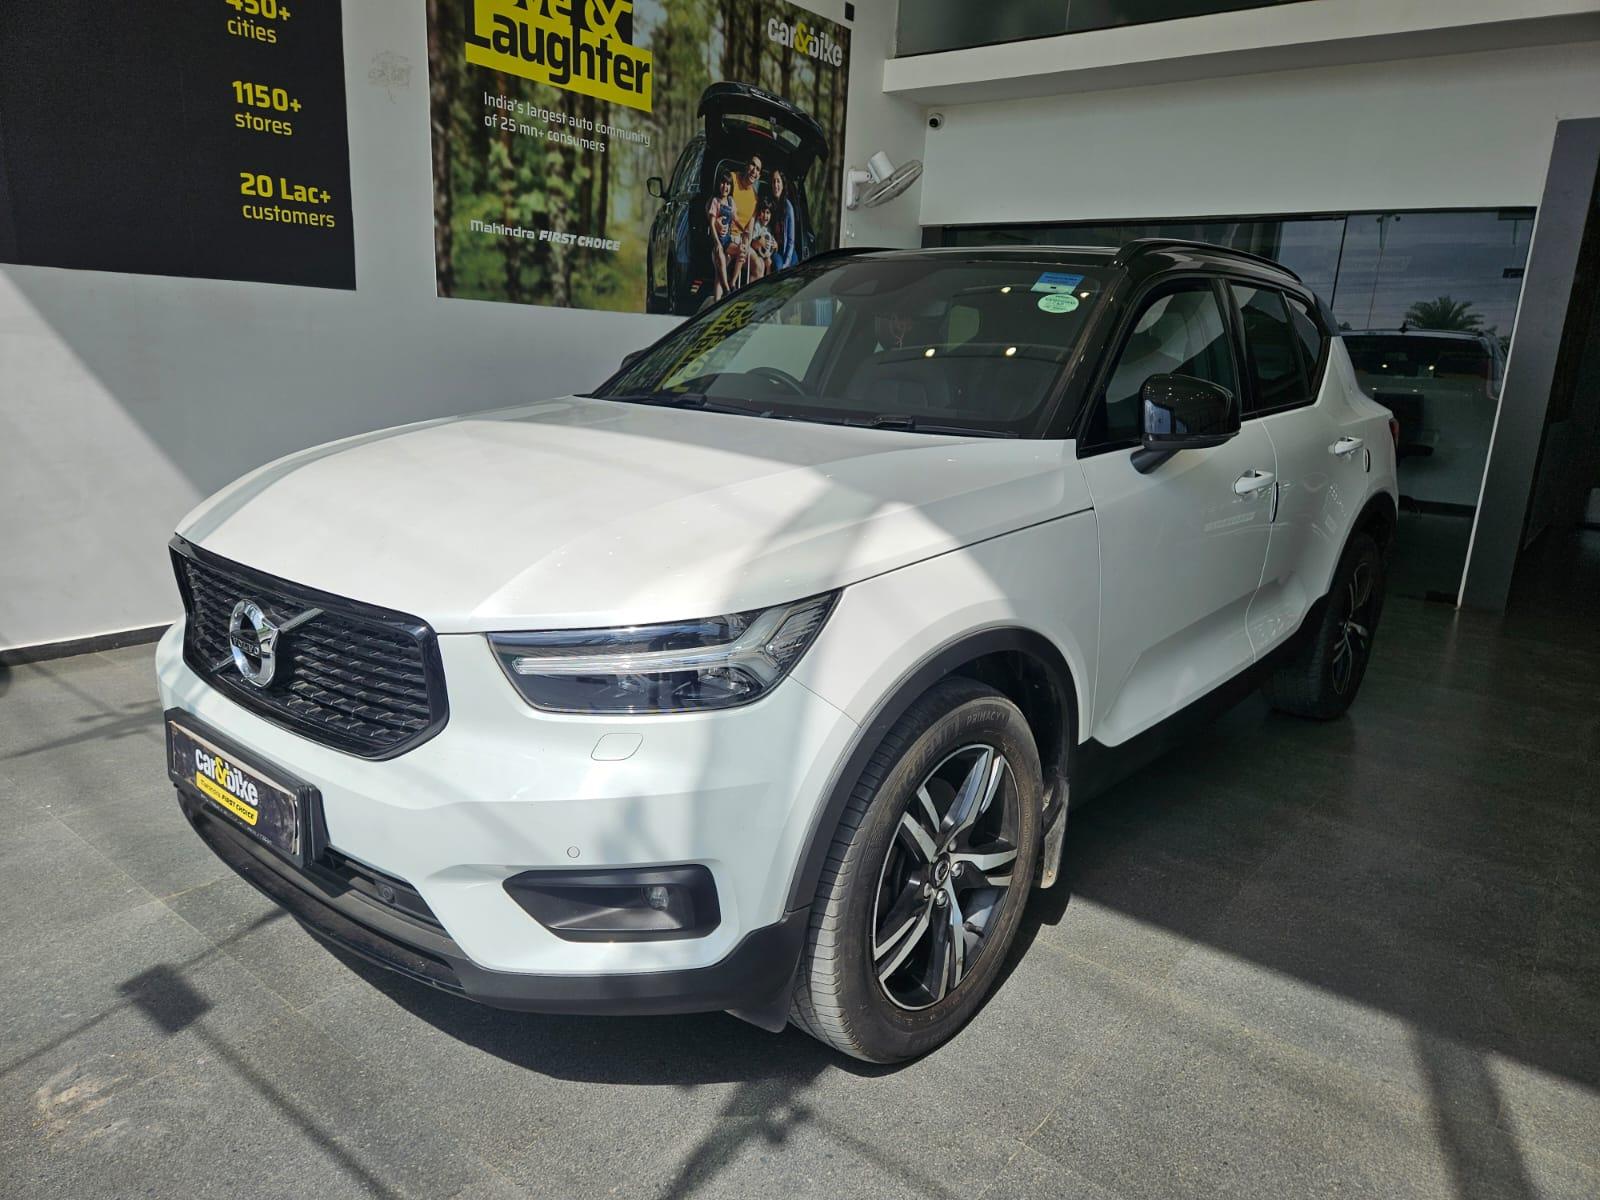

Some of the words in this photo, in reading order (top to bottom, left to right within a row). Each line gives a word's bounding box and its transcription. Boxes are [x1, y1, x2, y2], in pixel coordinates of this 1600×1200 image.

[227, 17, 277, 44] cities
[768, 18, 842, 67] car&bike
[465, 0, 650, 94] Laughter
[232, 81, 302, 112] 1150+
[235, 112, 293, 136] stores
[484, 91, 524, 114] India's
[527, 102, 567, 124] largest
[569, 116, 593, 131] auto
[595, 122, 650, 147] community
[484, 114, 498, 127] of
[501, 116, 516, 132] 25
[520, 123, 544, 138] mn+
[547, 129, 606, 152] consumers
[240, 172, 274, 198] 20
[280, 177, 331, 204] Lac+
[242, 204, 335, 228] customers
[470, 219, 535, 240] Mahindra
[538, 229, 578, 245] FIRST
[577, 235, 621, 251] CHOICE
[231, 635, 260, 655] VOLVO
[195, 748, 259, 806] car&bike
